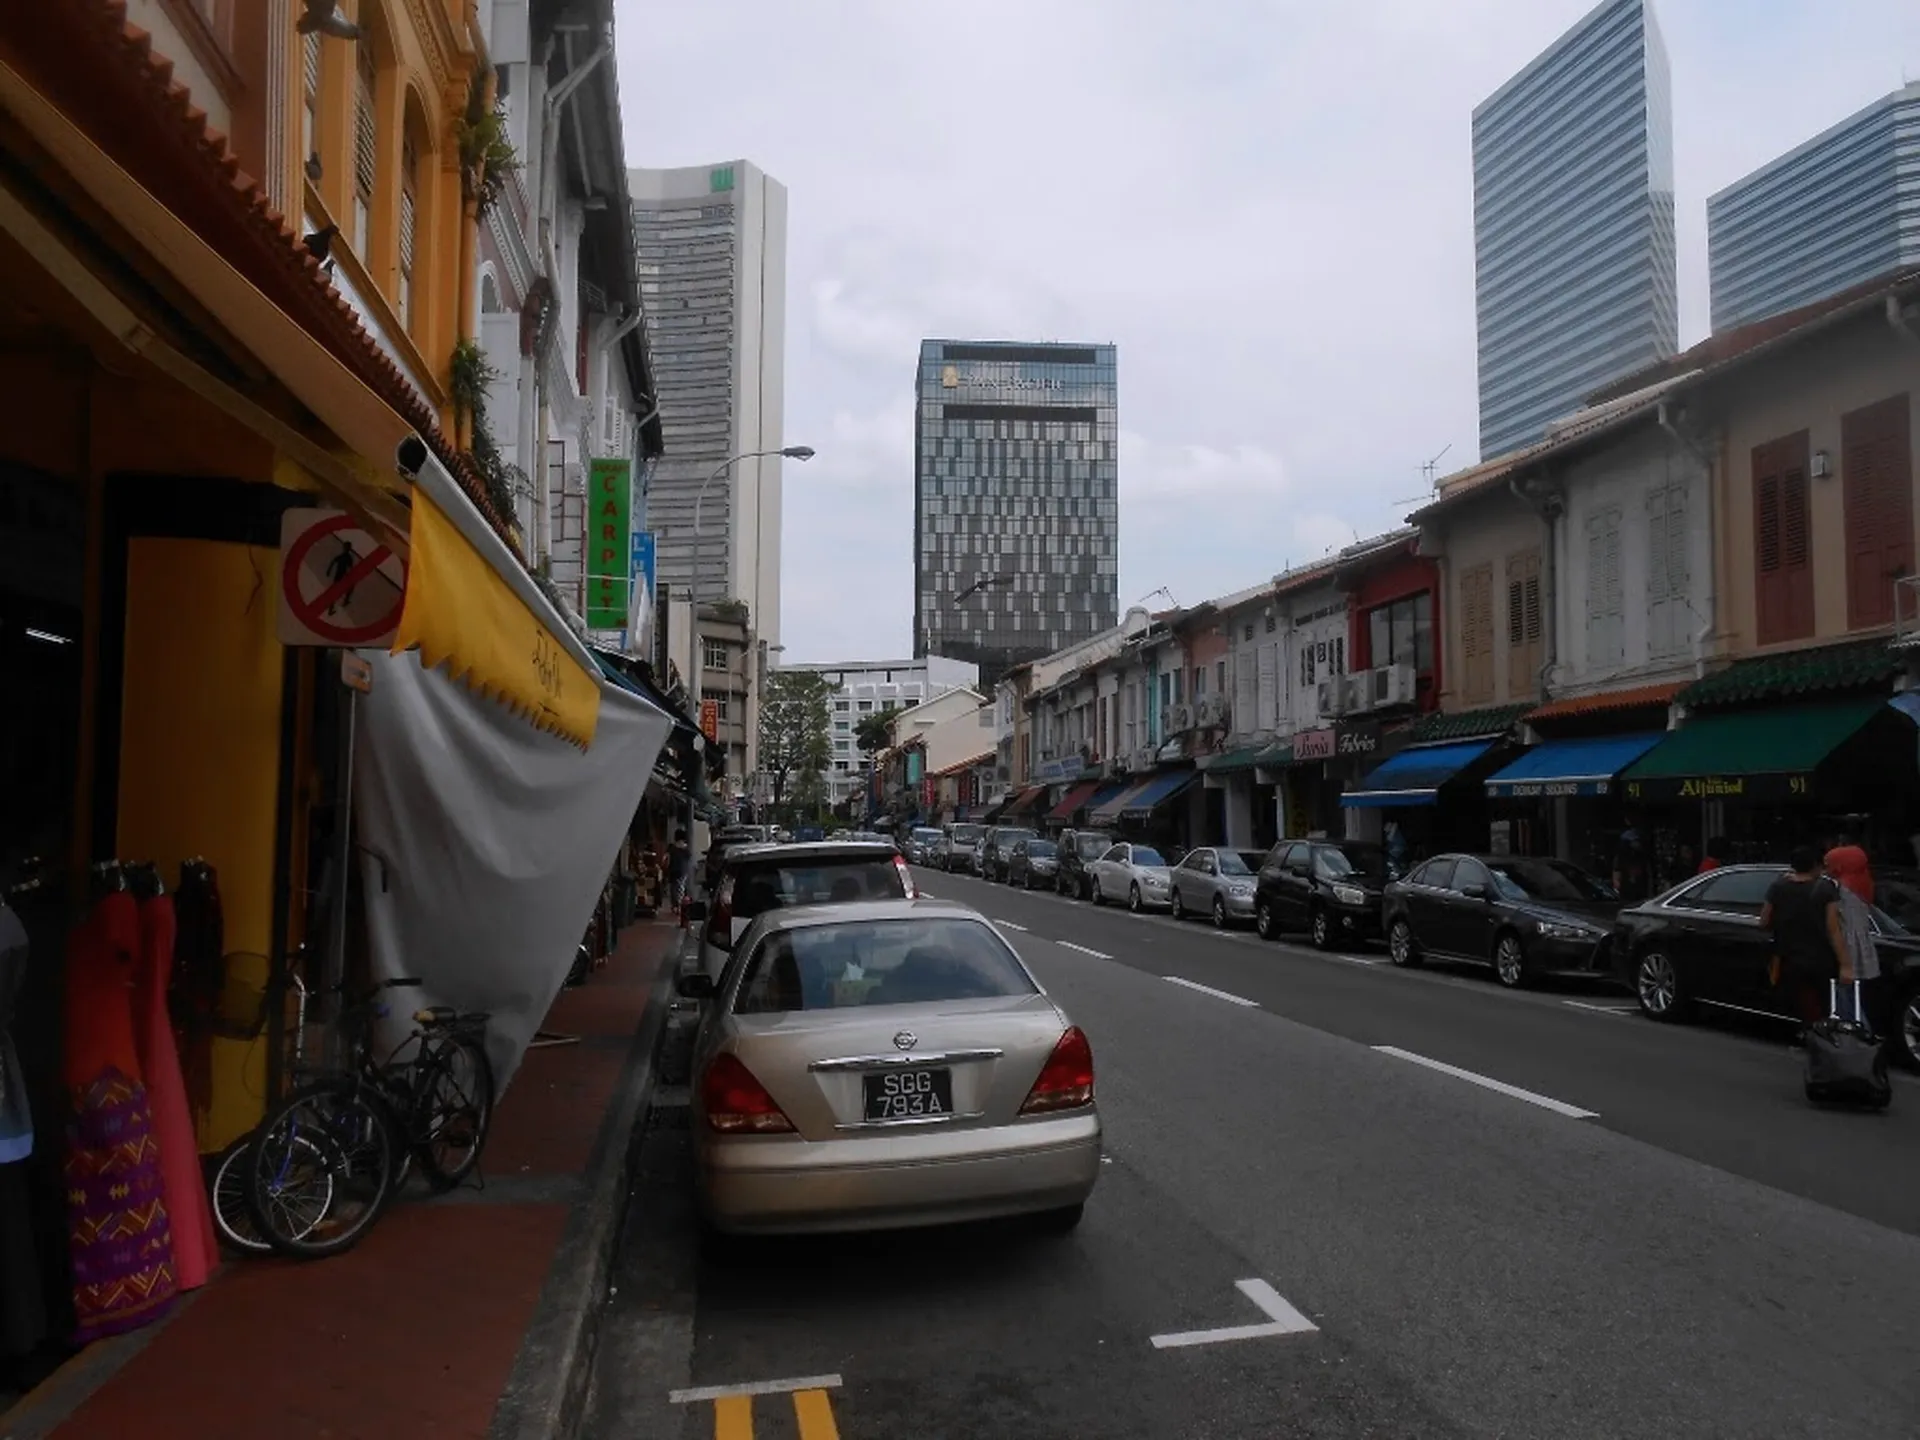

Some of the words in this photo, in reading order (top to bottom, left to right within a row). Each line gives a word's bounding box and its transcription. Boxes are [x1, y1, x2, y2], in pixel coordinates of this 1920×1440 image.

[602, 475, 617, 612] CARPET
[1790, 776, 1805, 794] 91
[884, 1072, 931, 1096] SGG
